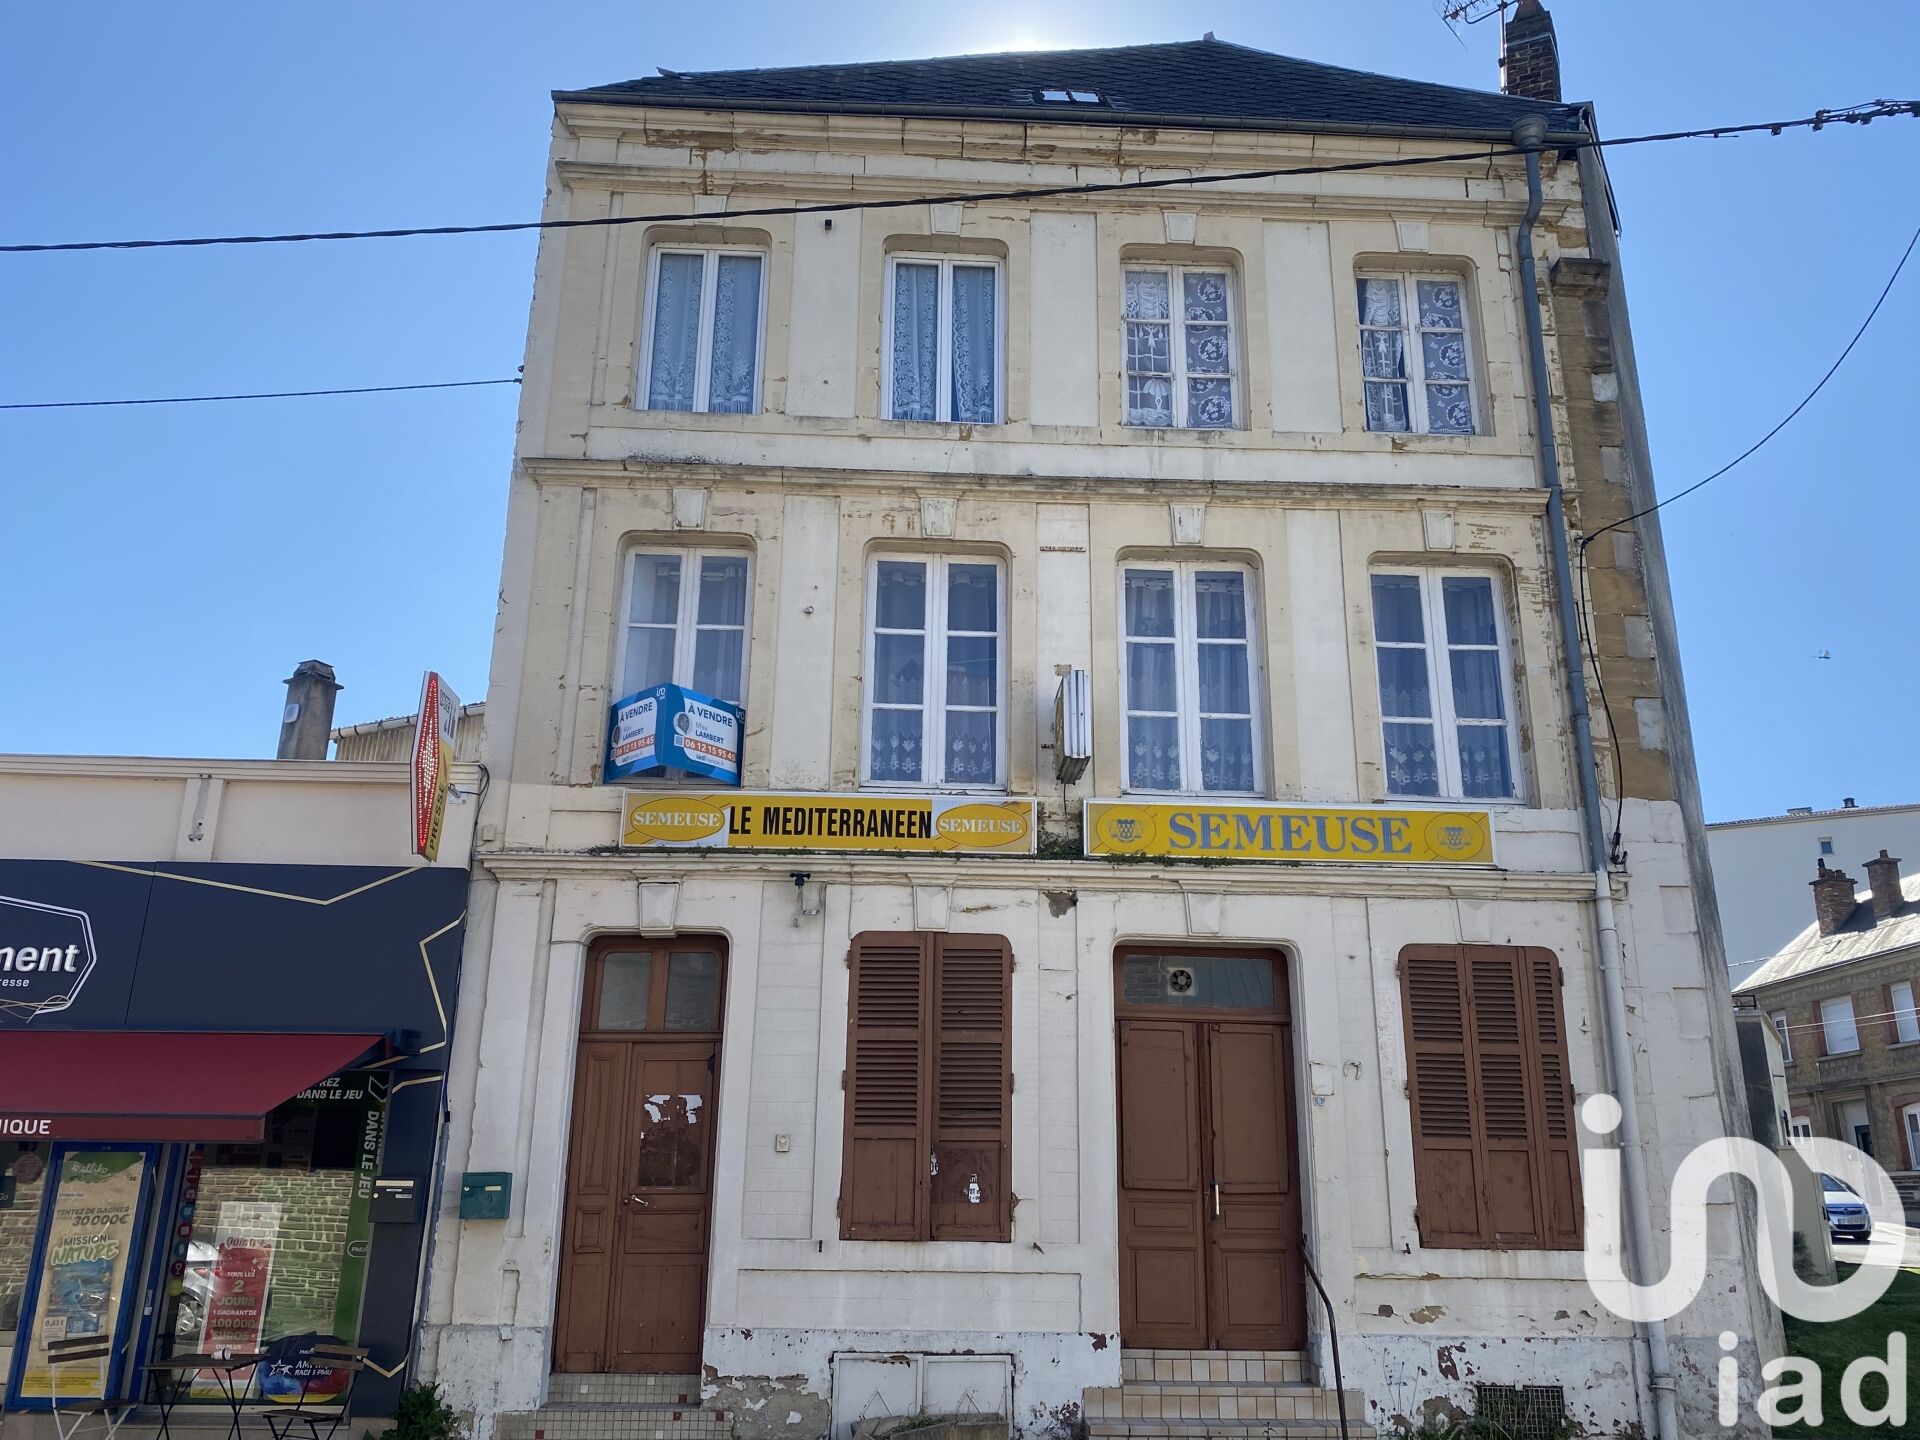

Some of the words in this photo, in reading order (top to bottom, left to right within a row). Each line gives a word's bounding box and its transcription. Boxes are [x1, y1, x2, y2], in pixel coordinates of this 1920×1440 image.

[619, 711, 625, 723] À
[625, 702, 653, 720] VENDRE
[687, 702, 696, 715] À
[696, 706, 733, 728] VENDRE
[622, 727, 644, 742] LAMBERT
[695, 729, 724, 745] LAMBERT
[685, 739, 695, 749] 06
[697, 742, 707, 752] 12
[708, 745, 717, 755] 15
[717, 748, 727, 758] 95
[727, 751, 737, 762] 45
[429, 782, 445, 851] PRESSE
[633, 810, 721, 829] SEMEUSE
[729, 805, 751, 836] LE
[762, 805, 932, 840] MEDITERRANEEN
[939, 817, 1023, 836] SEMEUSE
[1168, 812, 1413, 855] SEMEUSE
[296, 1089, 328, 1099] DANS
[329, 1089, 342, 1099] LE
[343, 1090, 364, 1100] JEU
[0, 1119, 52, 1135] IQUE
[363, 1110, 380, 1151] DANS
[361, 1154, 375, 1170] LE
[357, 1172, 373, 1199] JEU
[57, 1208, 84, 1216] TENTEZ
[96, 1206, 130, 1214] GAGNER
[63, 1234, 108, 1246] MISSION
[51, 1242, 119, 1265] NATURE
[232, 1279, 245, 1293] 2
[217, 1296, 256, 1306] JOURS
